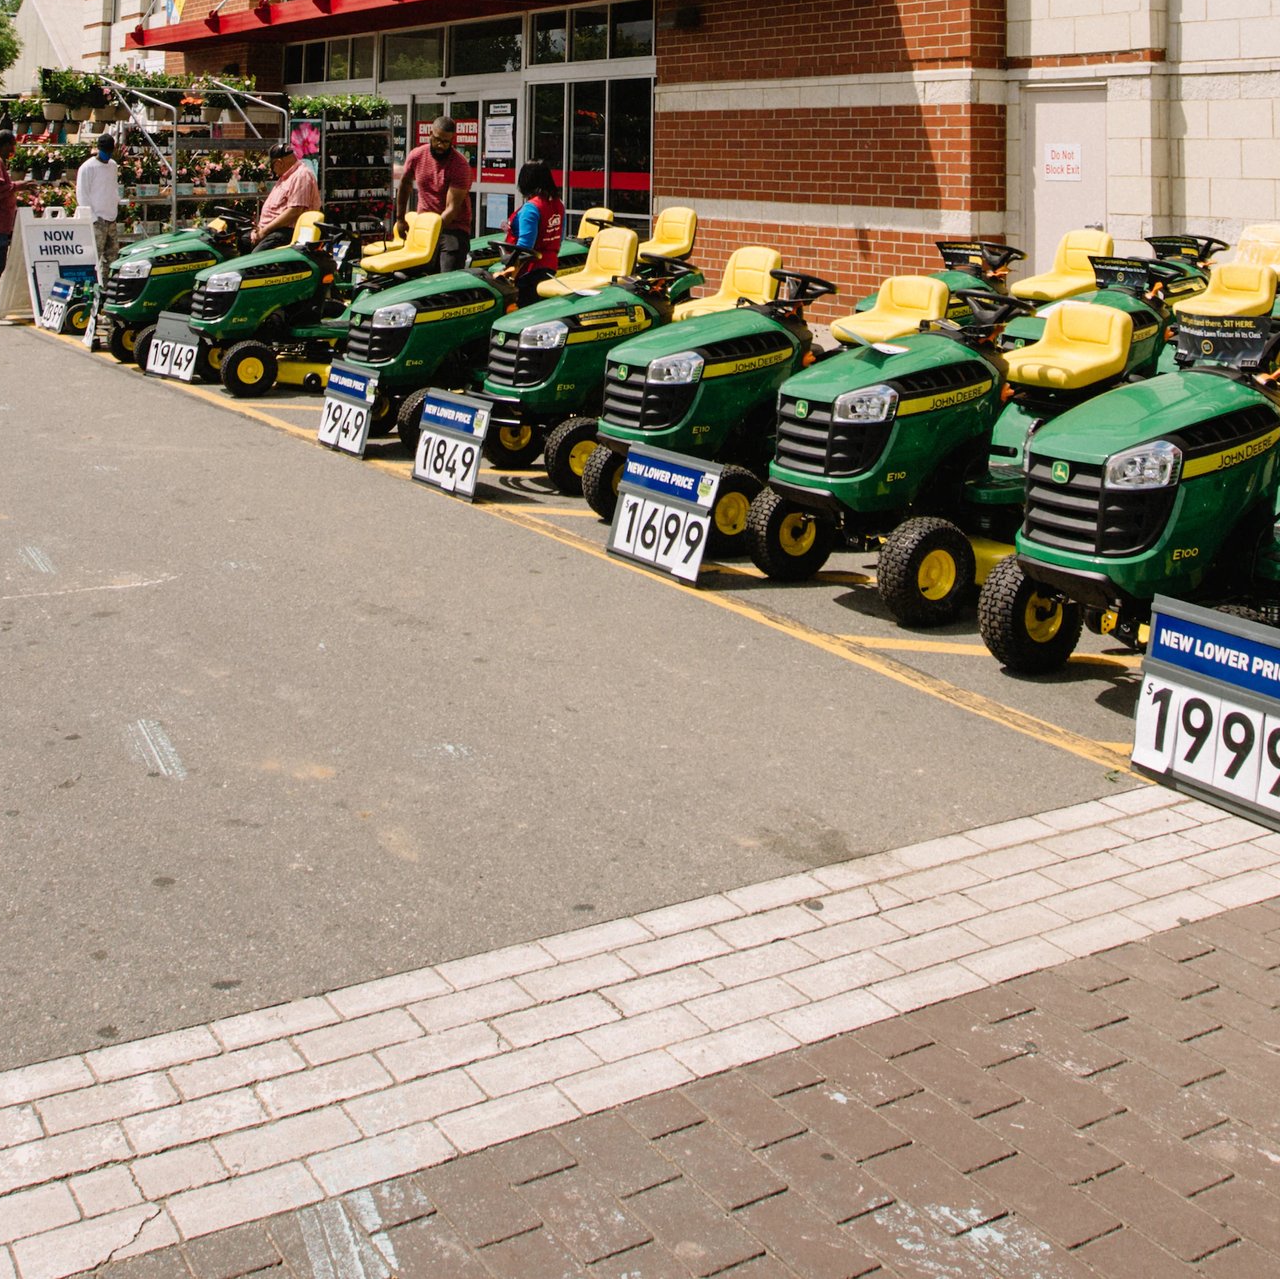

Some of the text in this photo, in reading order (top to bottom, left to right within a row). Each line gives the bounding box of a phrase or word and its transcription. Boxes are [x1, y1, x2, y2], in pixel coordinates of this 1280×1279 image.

[456, 122, 478, 133] ENTER
[1051, 150, 1075, 160] Do Not
[1045, 164, 1080, 175] Block Exit
[43, 230, 74, 241] NOW
[39, 244, 84, 256] HIRING
[263, 278, 281, 286] JOHN
[439, 303, 486, 320] JOHN DEERE
[1223, 320, 1234, 328] SIT
[1235, 320, 1256, 328] HERE.
[595, 324, 641, 340] JOHN DEERE
[153, 343, 194, 372] 1949
[405, 359, 423, 367] E140
[732, 353, 784, 373] JOHN DEERE
[329, 372, 339, 382] NEW
[338, 374, 354, 388] LOWER
[352, 379, 365, 392] PRICE
[556, 383, 576, 391] E130
[929, 385, 983, 411] JOHN DEERE
[424, 402, 438, 414] NEW
[437, 406, 456, 420] LOWER
[454, 412, 472, 425] PRICE
[326, 400, 365, 442] 1949
[691, 425, 711, 435] E110
[1218, 435, 1272, 470] JOHN DEERE
[627, 461, 644, 477] NEW
[643, 466, 671, 485] LOWER
[670, 472, 695, 491] PRICE
[886, 471, 907, 483] E110
[1172, 547, 1199, 561] E100
[1159, 627, 1195, 654] NEW
[1194, 641, 1250, 672] LOWER
